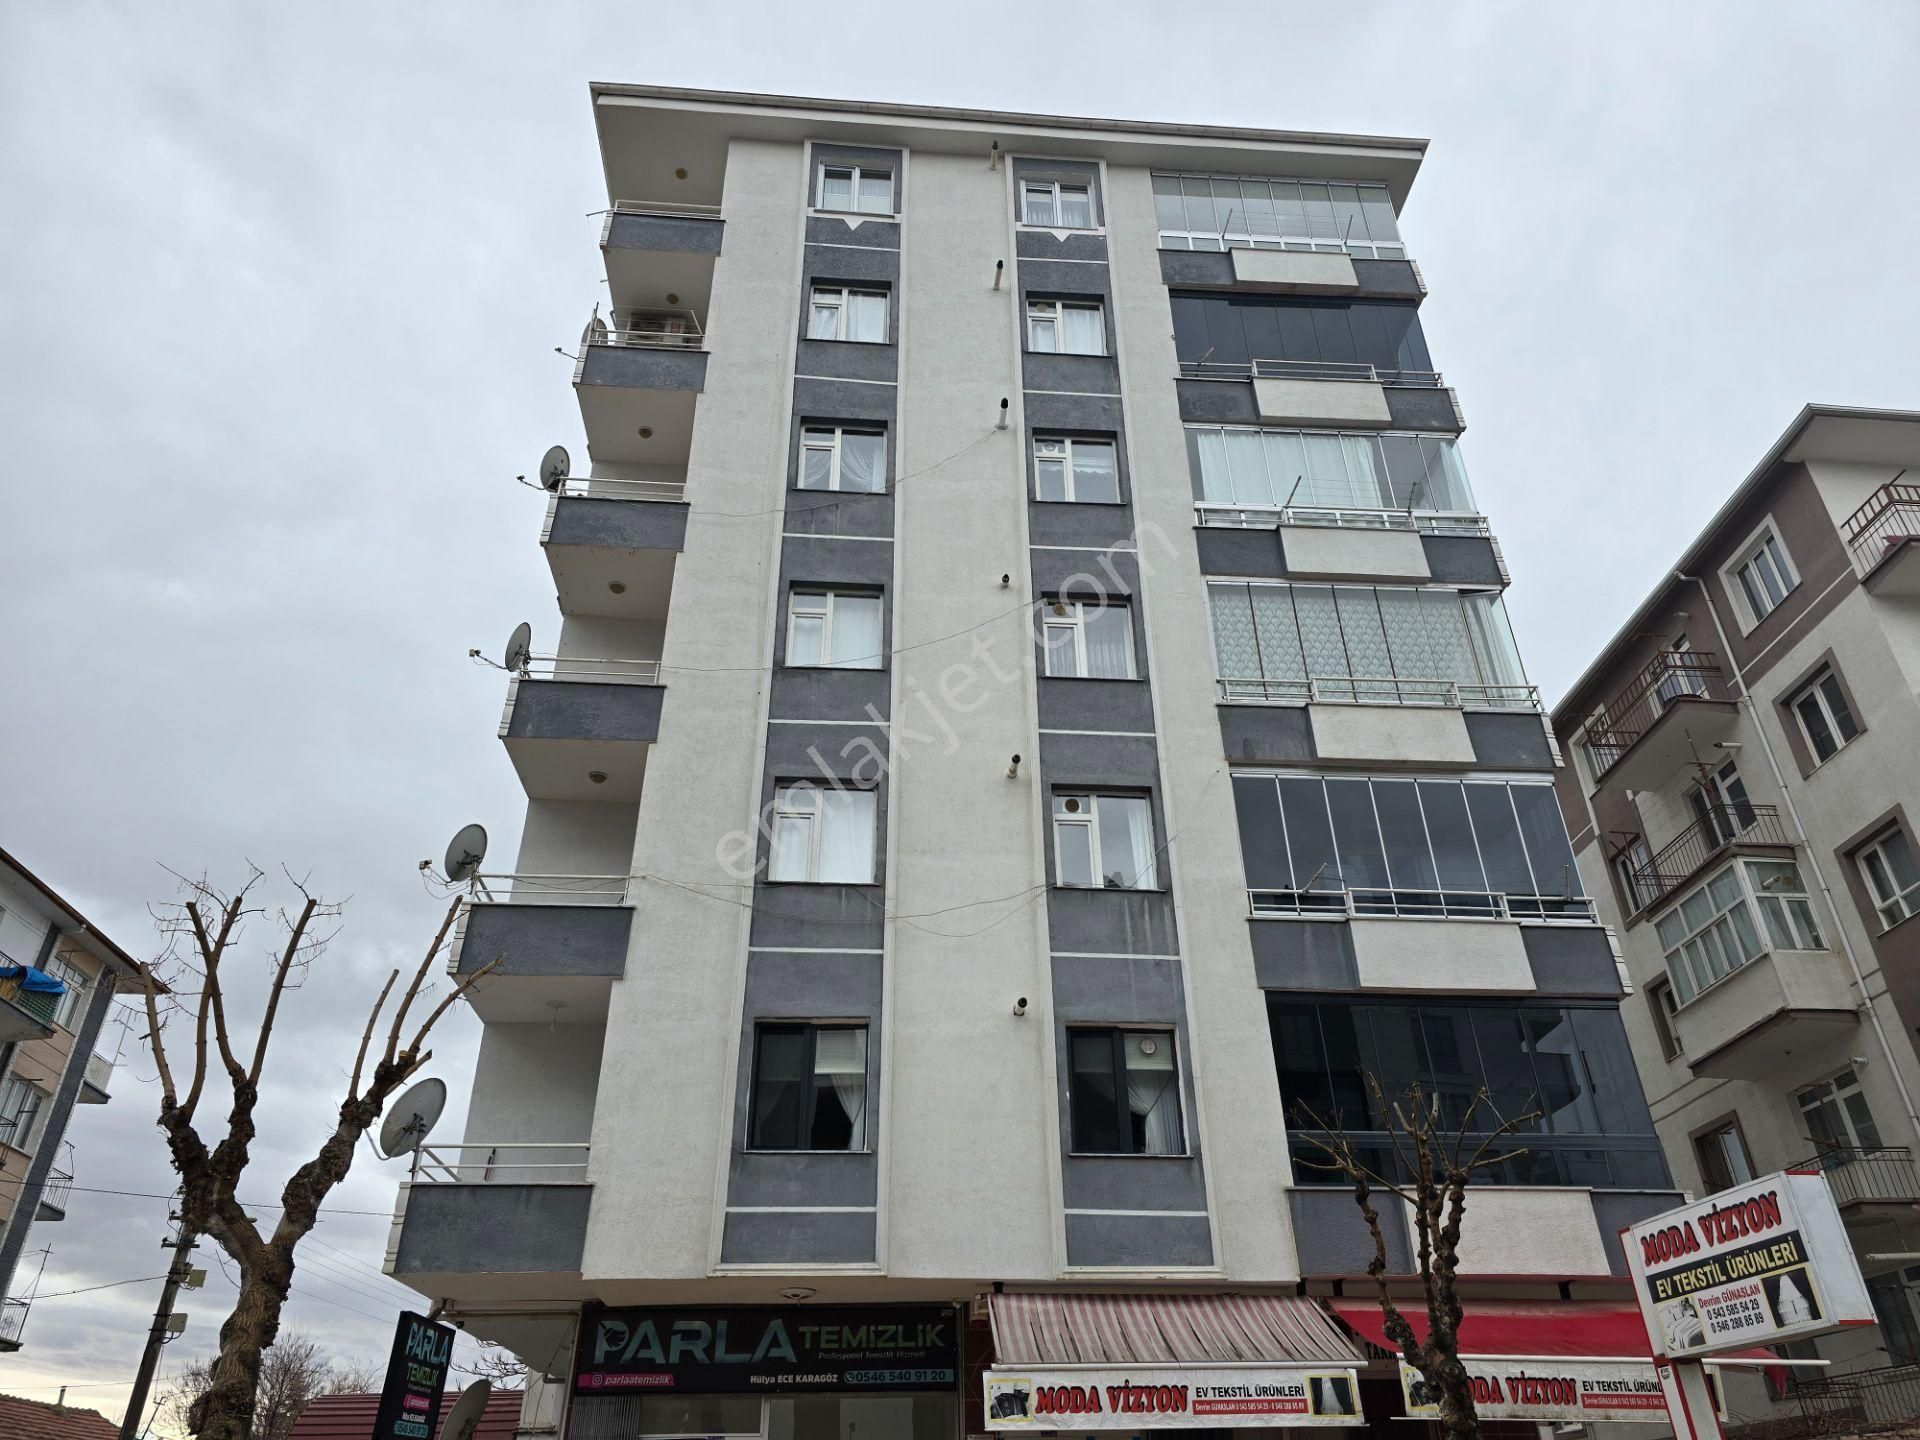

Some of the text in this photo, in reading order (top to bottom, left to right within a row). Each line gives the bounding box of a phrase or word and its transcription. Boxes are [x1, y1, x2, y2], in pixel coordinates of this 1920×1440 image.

[1640, 1191, 1782, 1267] MODA VİZYON
[1656, 1236, 1799, 1298] EV TEKSTİL ÜRÜNLERİ
[1698, 1283, 1761, 1309] Devrim GÜNASLAN
[1707, 1298, 1760, 1320] 0 543 585 54 29
[1710, 1312, 1764, 1334] 0 546 288 85 89
[405, 1322, 450, 1367] PARLA
[593, 1319, 798, 1365] PARLA
[818, 1350, 926, 1360] Profesyonel Temizlik Hizmeti
[604, 1375, 670, 1386] parlaatemizlik
[750, 1373, 838, 1385] Hülya ECE KARAGÖZ
[855, 1370, 946, 1382] 0546 540 91 20
[1582, 1379, 1663, 1392] EV TEKSTİL ÜRÜNL
[1035, 1379, 1188, 1414] MODA VİZYON
[1196, 1383, 1305, 1398] EV TEKSTİL ÜRÜNLERİ
[1466, 1371, 1577, 1405] ODA VİZYON
